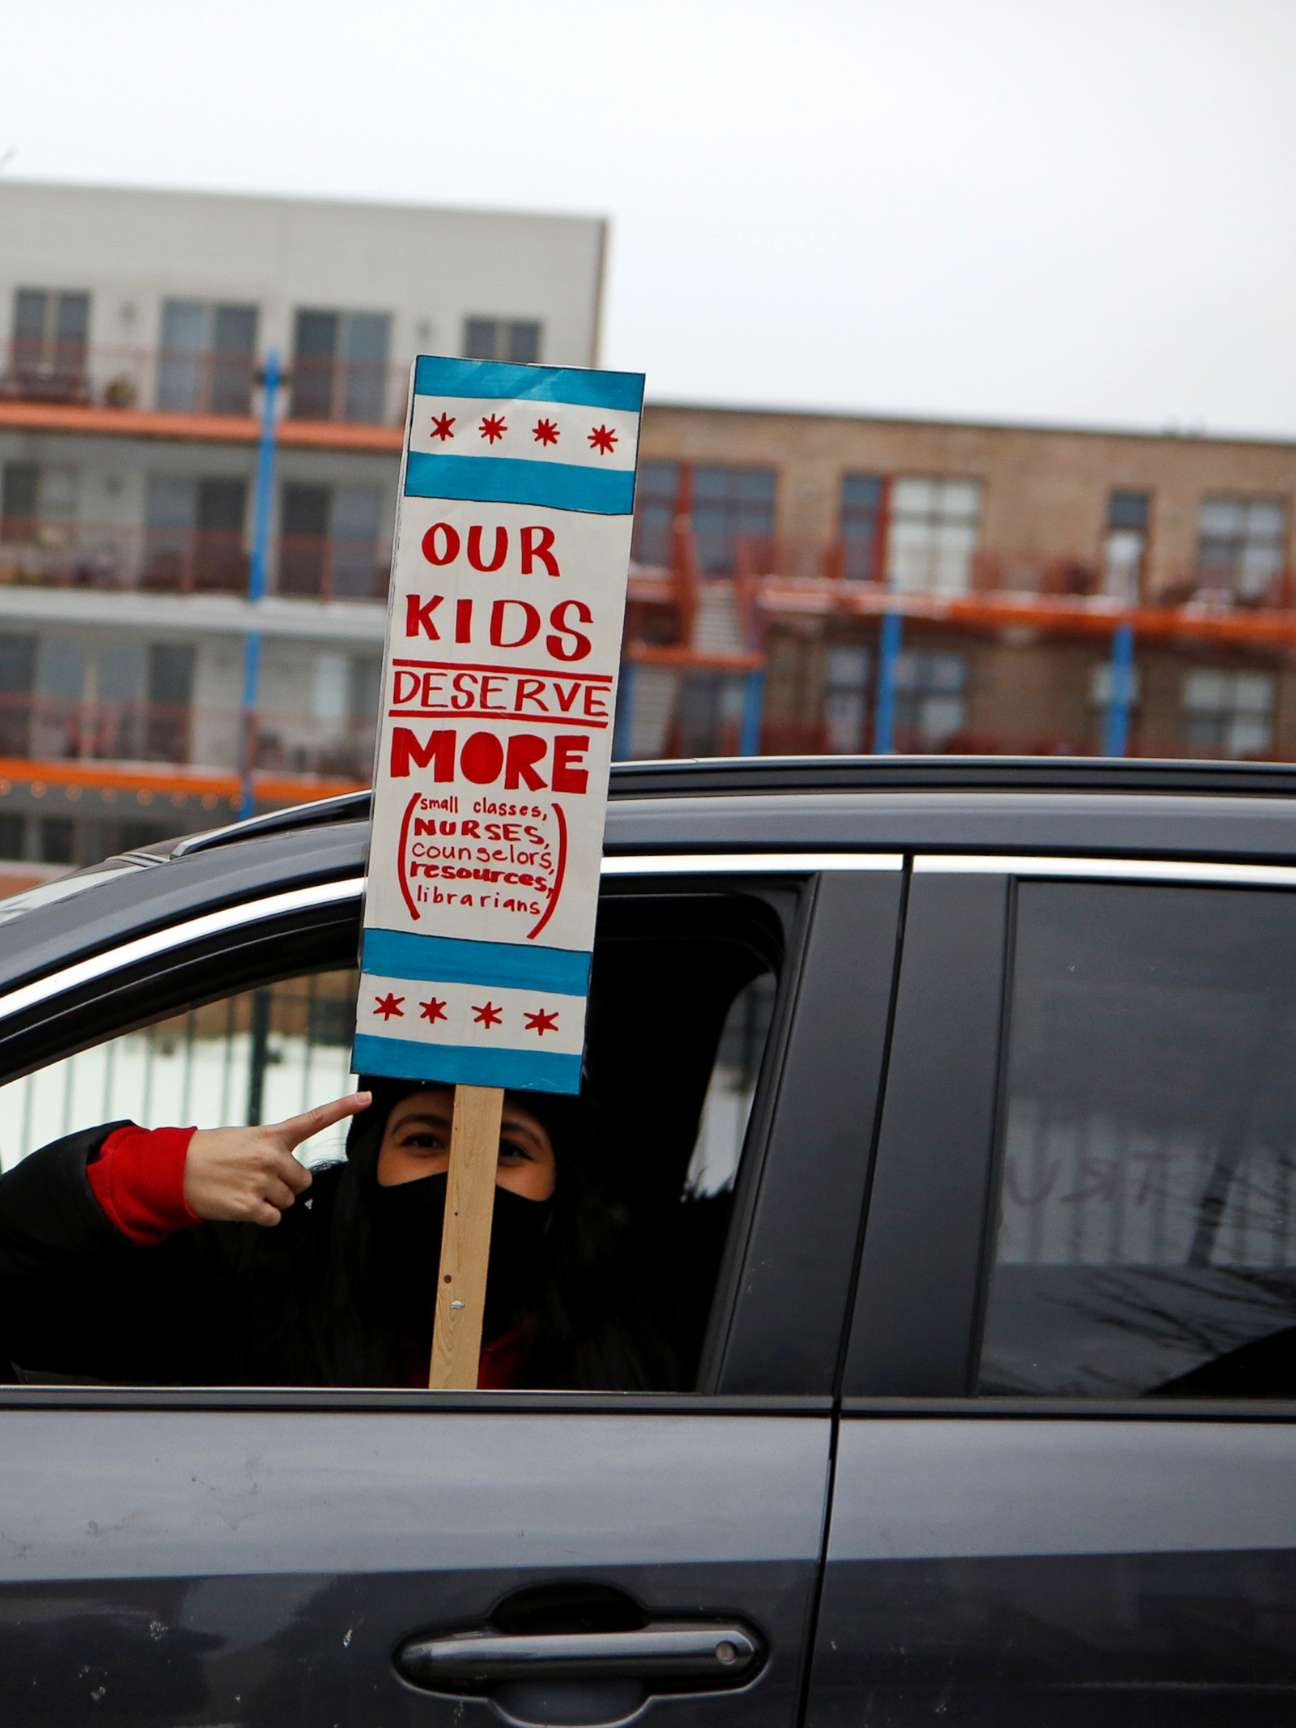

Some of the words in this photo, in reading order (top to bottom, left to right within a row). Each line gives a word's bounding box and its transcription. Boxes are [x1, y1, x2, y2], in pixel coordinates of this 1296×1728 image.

[421, 523, 560, 577] OUR
[405, 594, 593, 662] KIDS
[393, 671, 612, 717] DESERVE
[390, 727, 591, 794] MORE
[473, 797, 548, 821] classes,
[414, 817, 550, 849] NURSES,
[410, 861, 556, 899] resources,
